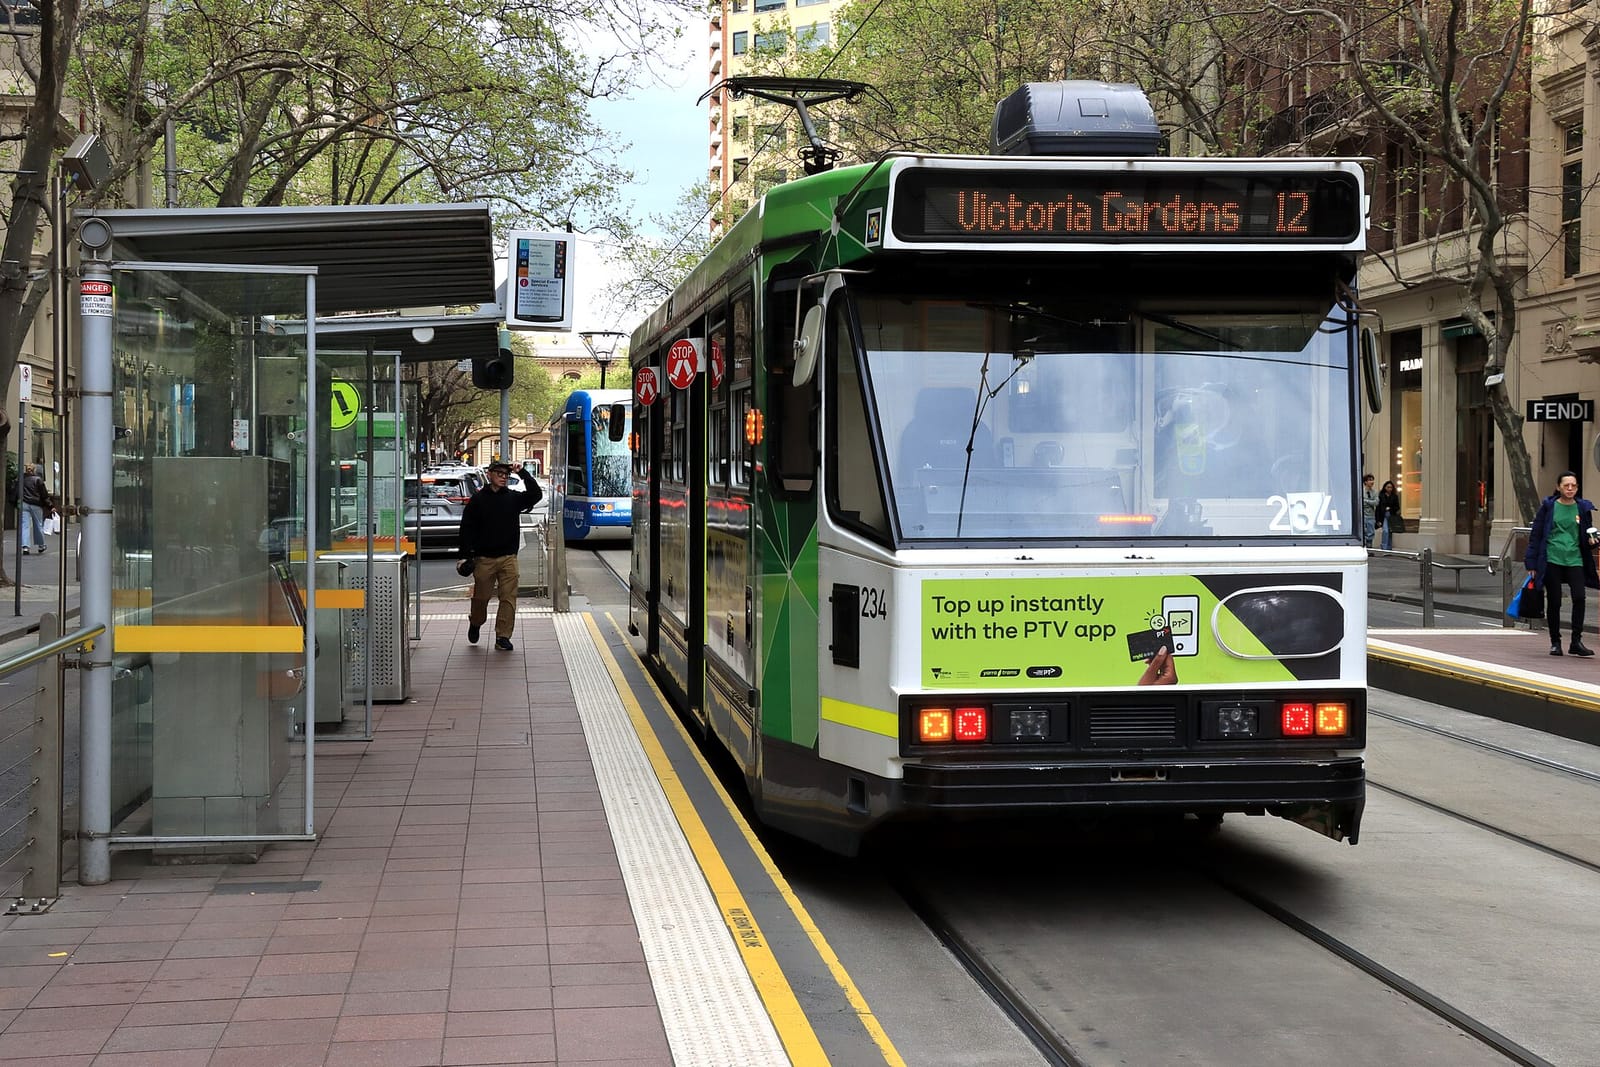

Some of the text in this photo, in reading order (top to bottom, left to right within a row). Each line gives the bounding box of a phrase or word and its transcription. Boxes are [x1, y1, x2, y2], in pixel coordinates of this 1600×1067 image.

[958, 190, 1310, 232] Victoria Gardens 12
[671, 345, 694, 360] STOP
[638, 372, 654, 383] STOP
[1533, 402, 1588, 420] FENDI
[1266, 495, 1342, 531] 234
[861, 586, 887, 621] 234
[931, 594, 1105, 618] Top up instantly
[931, 621, 1117, 642] with the PTV app
